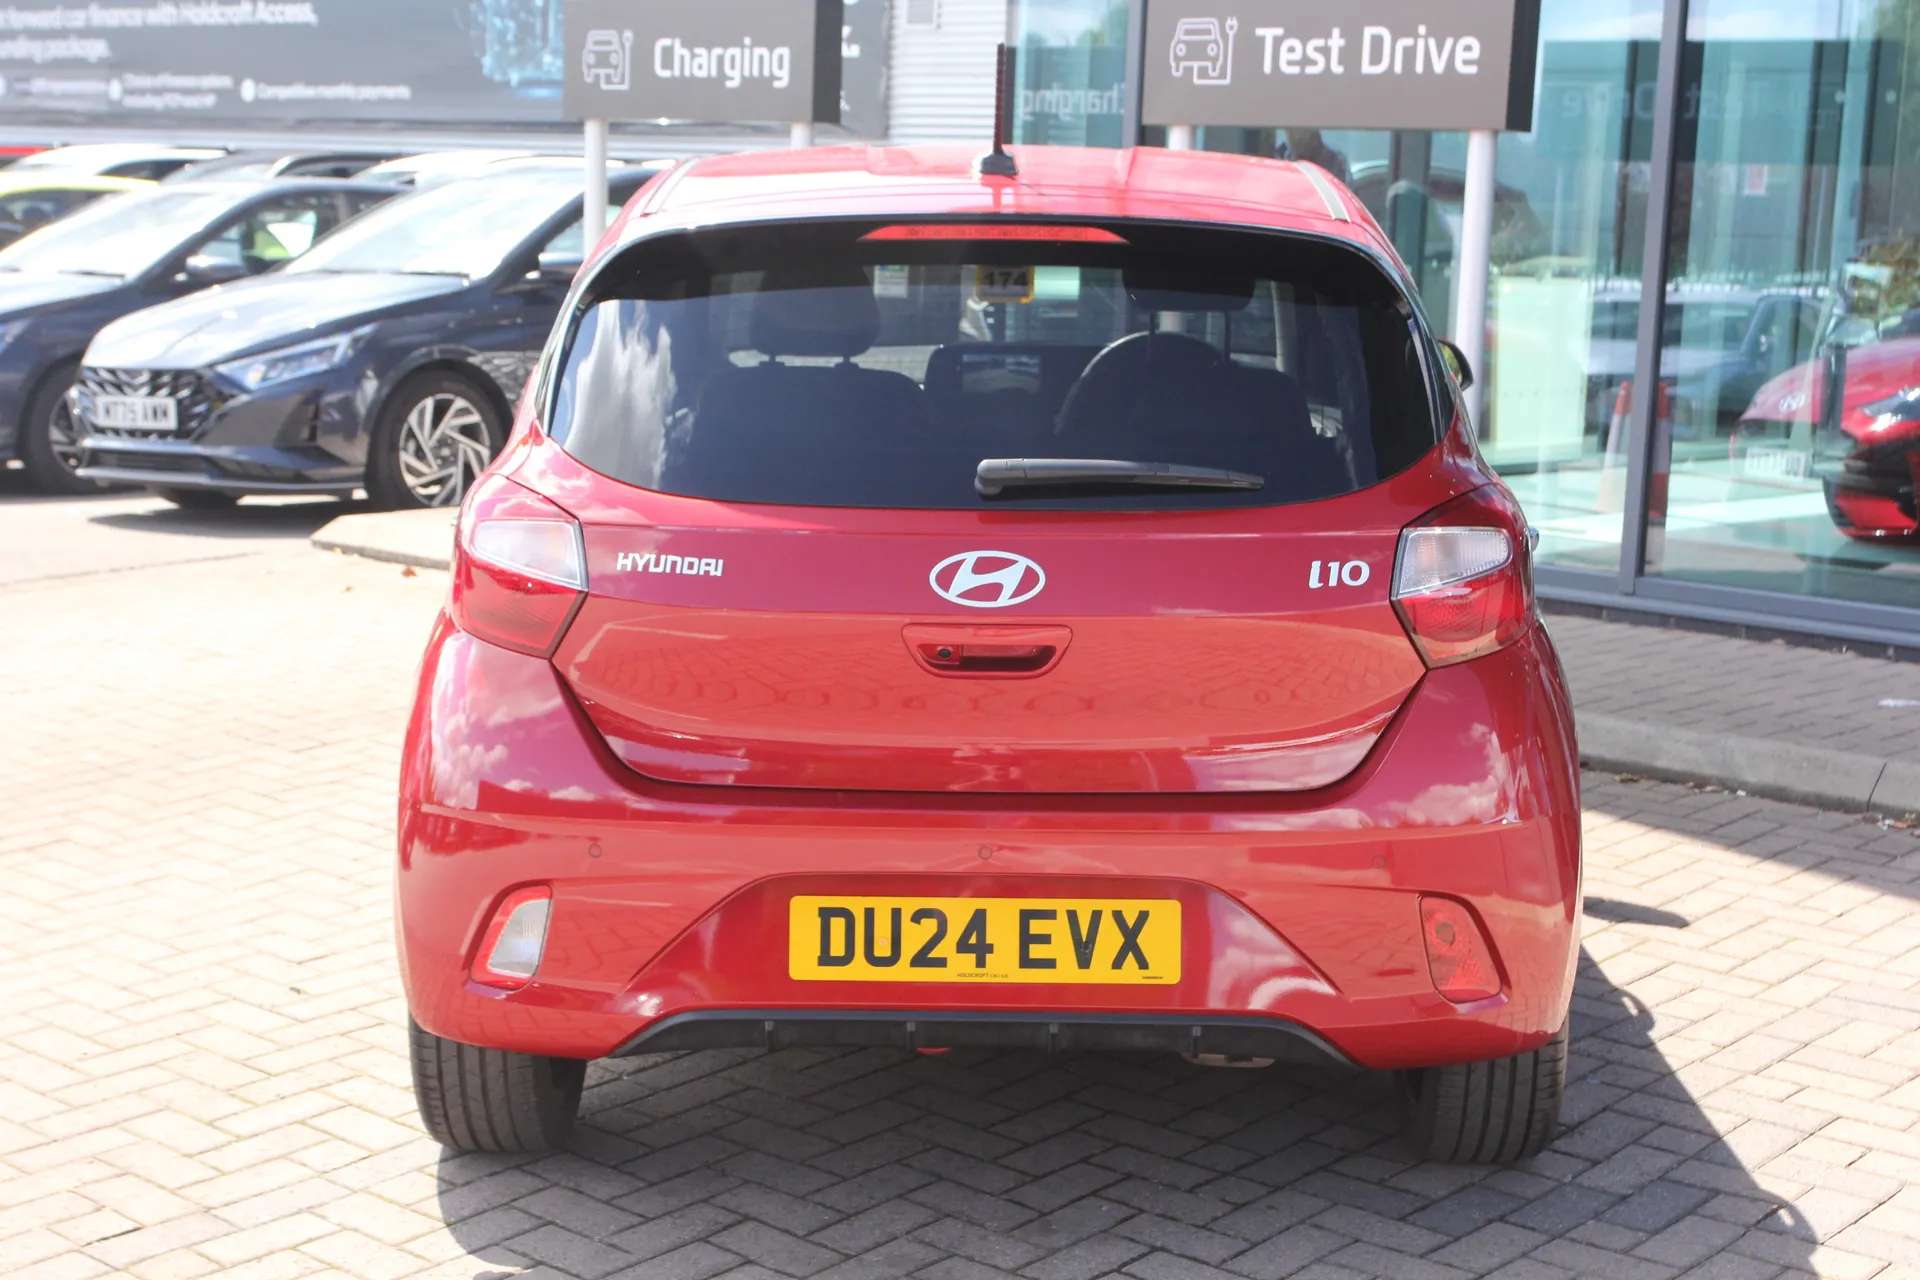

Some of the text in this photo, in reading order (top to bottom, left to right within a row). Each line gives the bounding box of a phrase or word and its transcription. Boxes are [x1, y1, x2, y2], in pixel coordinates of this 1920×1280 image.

[653, 37, 791, 89] Charging
[1255, 25, 1482, 76] Test Drive
[616, 552, 724, 577] HYUNDAI
[817, 906, 1151, 971] DU24 EVX
